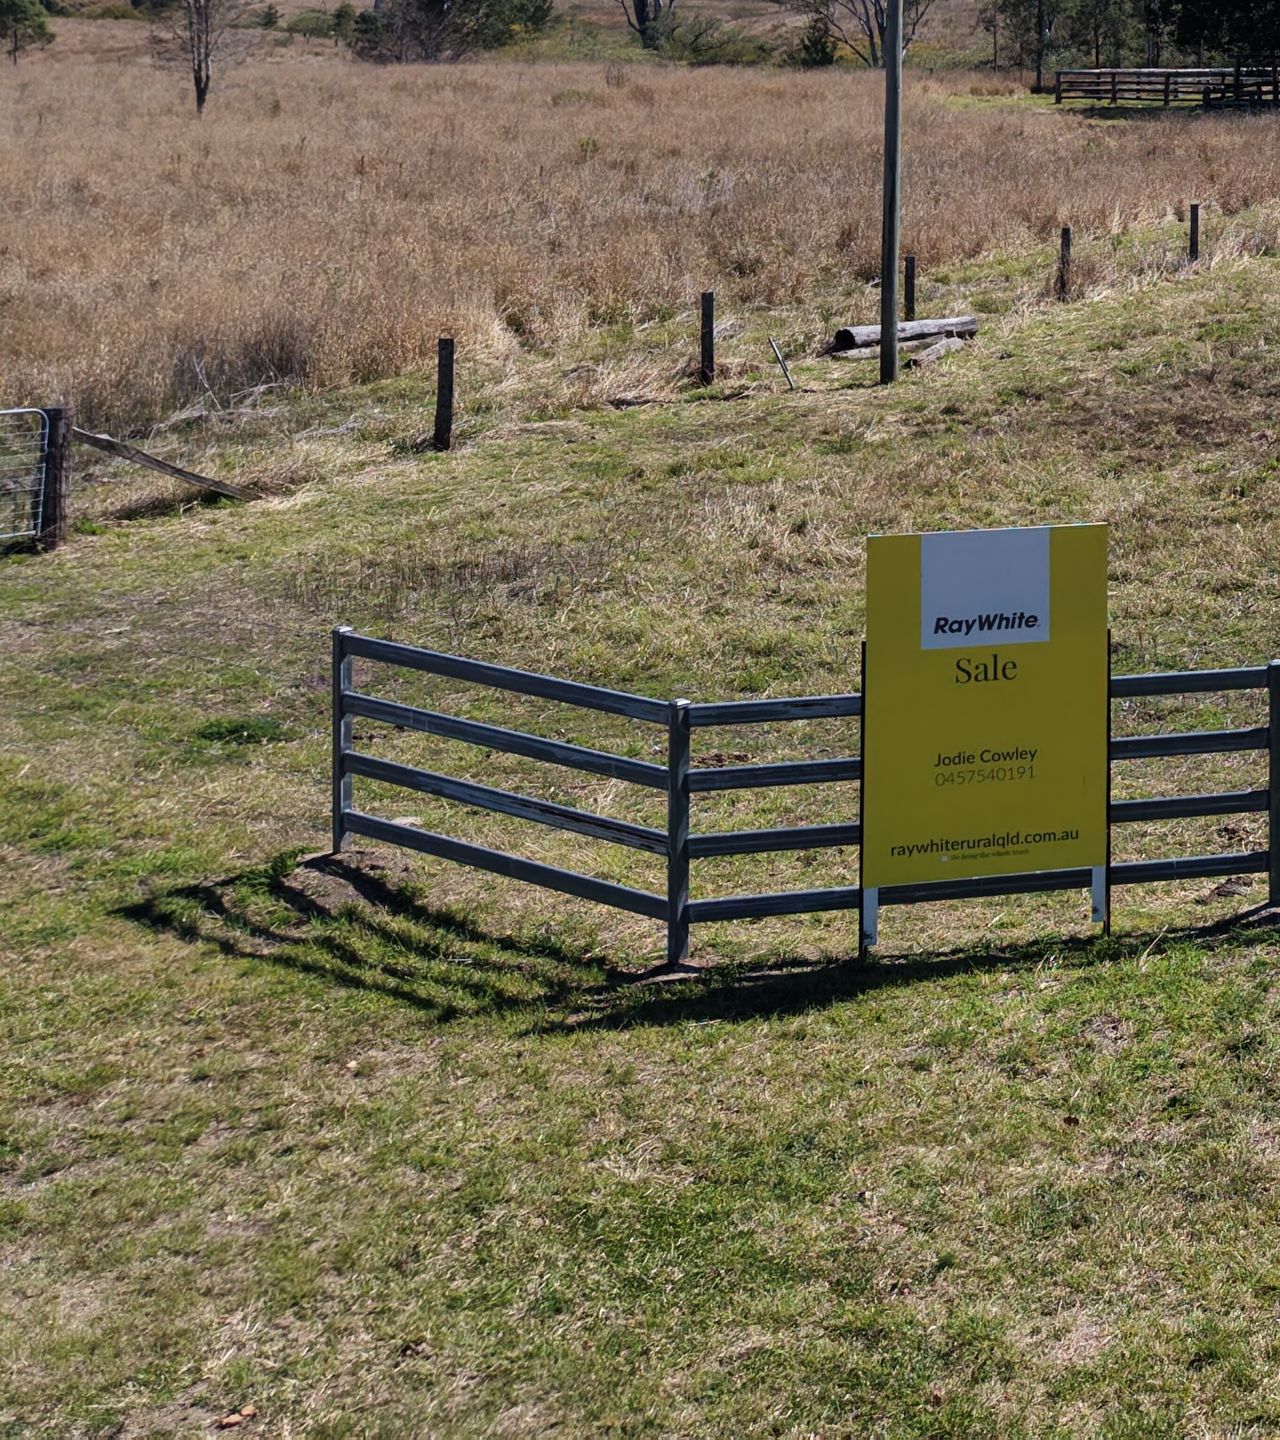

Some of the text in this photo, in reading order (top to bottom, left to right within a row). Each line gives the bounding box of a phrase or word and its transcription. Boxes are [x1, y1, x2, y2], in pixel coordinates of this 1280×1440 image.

[933, 612, 1038, 636] RayWhite
[955, 654, 1017, 684] Sale
[934, 747, 1038, 767] Jodie Cowley
[934, 765, 1036, 787] 0457540191
[890, 829, 1080, 857] raywhiteruralqld.com.au
